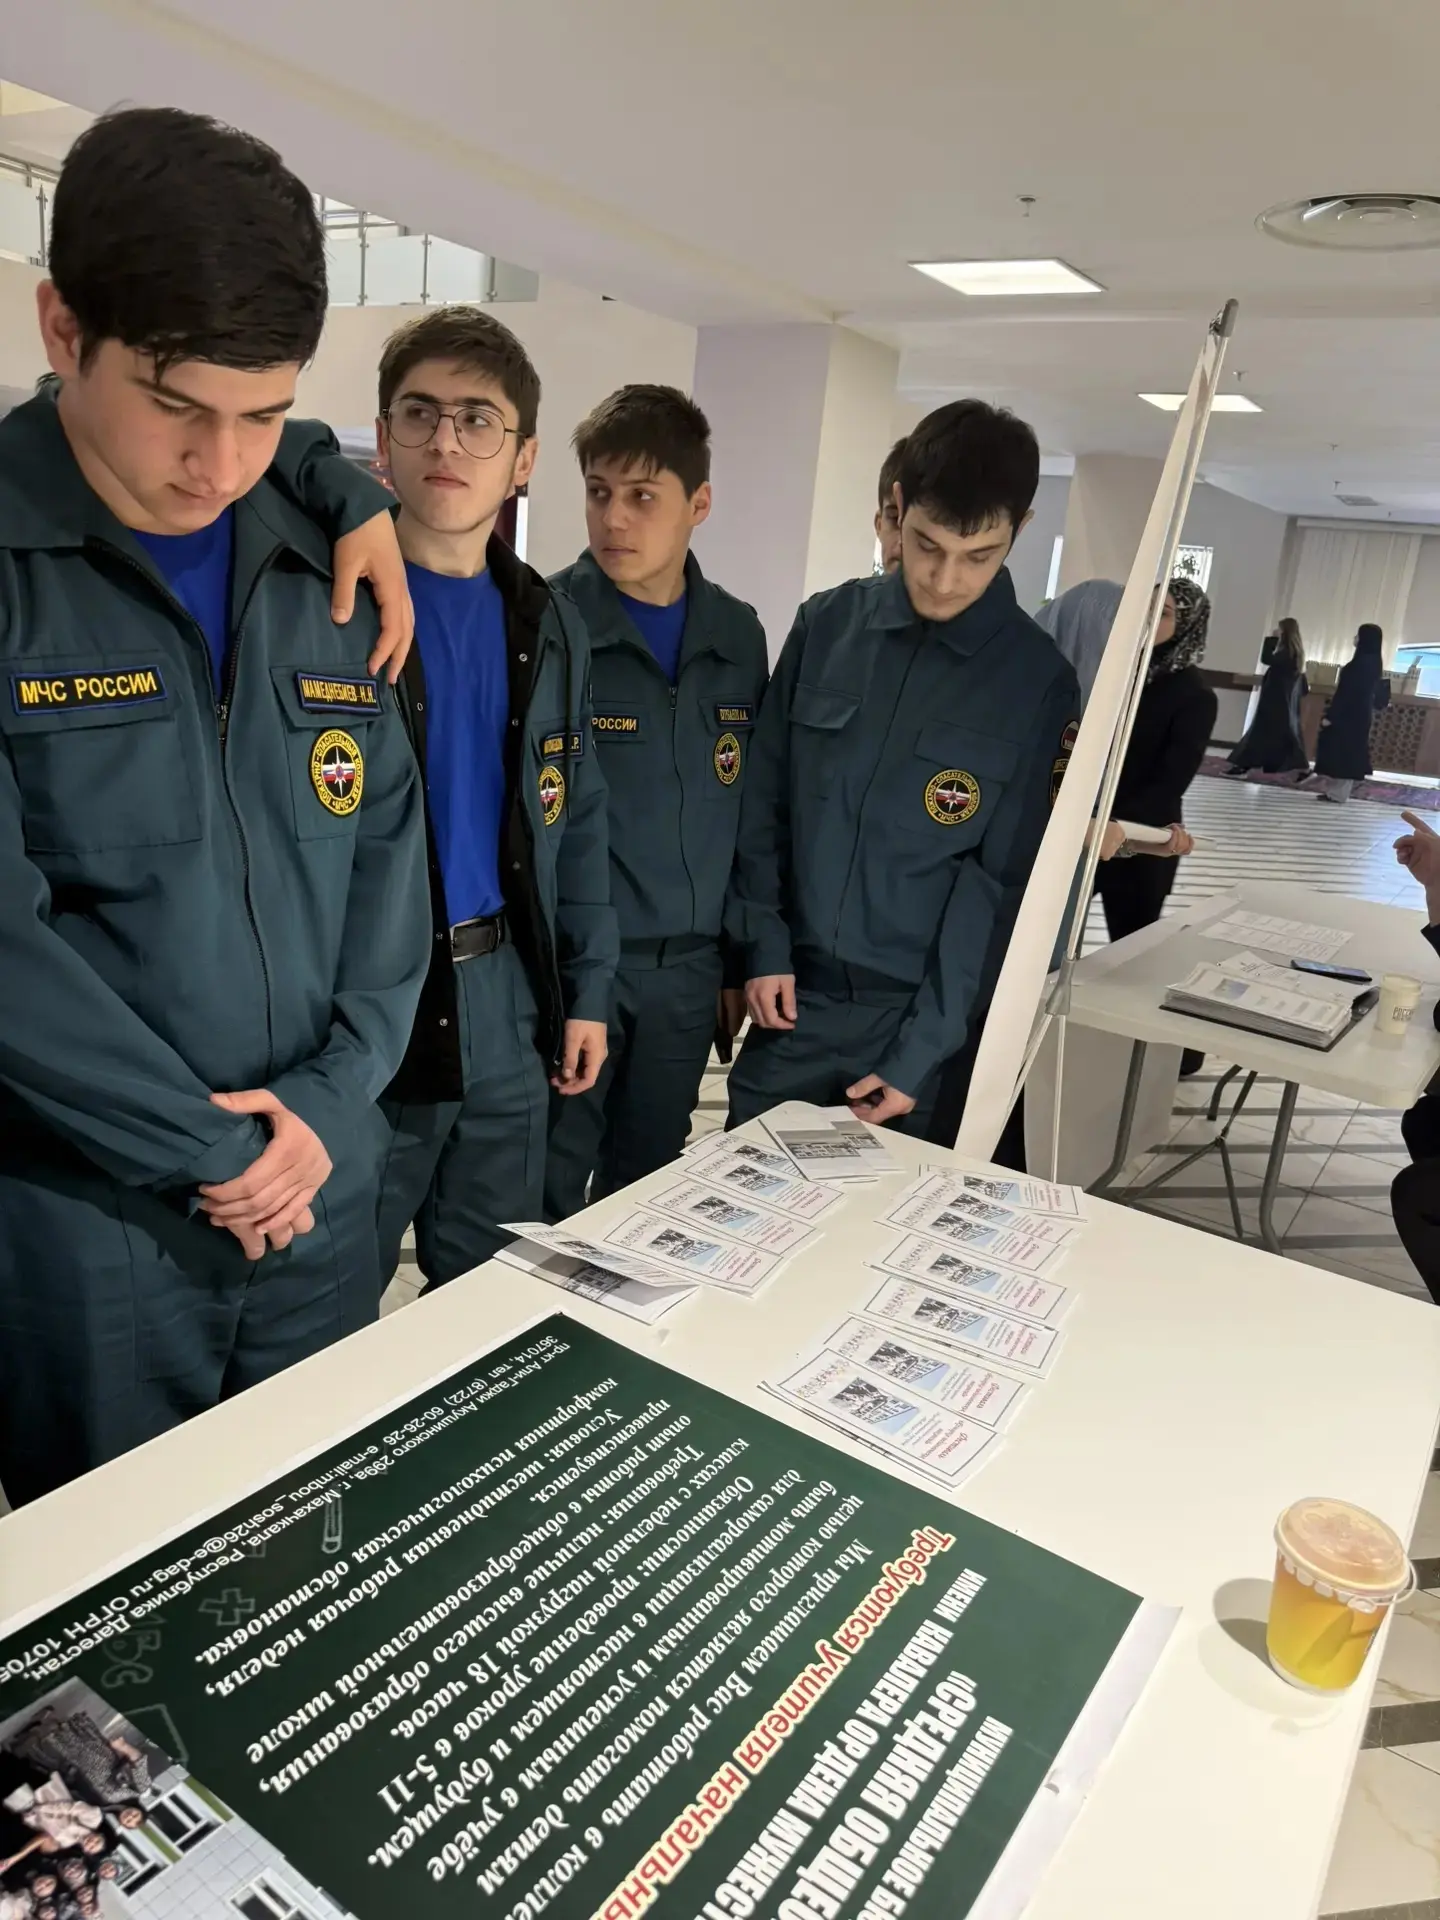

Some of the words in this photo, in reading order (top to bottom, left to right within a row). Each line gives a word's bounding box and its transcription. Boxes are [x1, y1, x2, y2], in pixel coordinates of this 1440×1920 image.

[20, 681, 67, 704] МЧС
[74, 671, 157, 699] РОССИИ
[475, 1360, 542, 1404] Али-Гаджи
[488, 1363, 513, 1378] тел
[508, 1335, 558, 1363] 367014,
[540, 1342, 571, 1363] пр-кт
[382, 1406, 445, 1446] 60-26-26
[443, 1378, 488, 1406] (8722)
[514, 1377, 619, 1451] комфортная
[392, 1401, 478, 1457] Акушинского
[529, 1399, 671, 1504] приветствуется.
[543, 1408, 624, 1463] Условия:
[645, 1415, 691, 1452] опыт
[688, 1437, 750, 1490] классах
[337, 1481, 352, 1490] г.
[348, 1454, 395, 1480] 299а,
[580, 1445, 650, 1504] работы
[600, 1444, 705, 1525] Требования:
[678, 1486, 692, 1500] с
[770, 1469, 806, 1496] для
[790, 1480, 838, 1519] быть
[240, 1488, 342, 1547] Махачкала,
[351, 1448, 516, 1564] психологическая
[402, 1460, 546, 1565] шестидневная
[568, 1501, 583, 1514] в
[592, 1495, 683, 1576] недельной
[636, 1476, 754, 1577] Обязанности:
[818, 1494, 865, 1540] целью
[129, 1548, 246, 1618] Республика
[523, 1522, 605, 1590] наличие
[644, 1493, 775, 1616] самореализации
[647, 1516, 796, 1662] мотивированным
[749, 1537, 824, 1613] которого
[834, 1538, 874, 1572] Мы
[63, 1596, 130, 1639] ОГРН
[195, 1561, 349, 1665] обстановка.
[307, 1556, 403, 1632] рабочая
[335, 1511, 569, 1698] общеобразовательной
[432, 1586, 524, 1663] высшего
[495, 1569, 596, 1658] нагрузкой
[529, 1574, 641, 1674] проведение
[631, 1612, 648, 1628] в
[740, 1567, 842, 1675] приглашаем
[832, 1525, 958, 1655] Требуются
[932, 1567, 988, 1624] ИМЕНИ
[23, 1613, 131, 1680] Дагестан,
[205, 1628, 307, 1697] неделя,
[466, 1651, 501, 1684] 18
[631, 1659, 653, 1679] и
[665, 1608, 753, 1700] является
[854, 1618, 955, 1728] КАВАЛЕРА
[390, 1680, 469, 1738] часов.
[453, 1663, 532, 1741] уроков
[510, 1624, 636, 1741] настоящем
[706, 1670, 753, 1715] Вас
[732, 1638, 852, 1776] учителя
[246, 1690, 336, 1763] школе
[259, 1660, 430, 1794] образования,
[434, 1738, 452, 1758] в
[489, 1738, 512, 1761] и
[518, 1668, 637, 1790] успешным
[562, 1695, 670, 1804] помогать
[859, 1670, 978, 1821] «СРЕДНЯЯ
[377, 1754, 438, 1814] 5-11
[500, 1787, 519, 1808] в
[601, 1703, 712, 1826] работать
[785, 1718, 880, 1820] ОРДЕНА
[367, 1757, 494, 1867] будущем.
[426, 1796, 504, 1881] учёбе
[584, 1826, 604, 1849] в
[881, 1715, 1014, 1899] МУНИЦИПАЛЬНОЕ
[476, 1803, 570, 1895] детям
